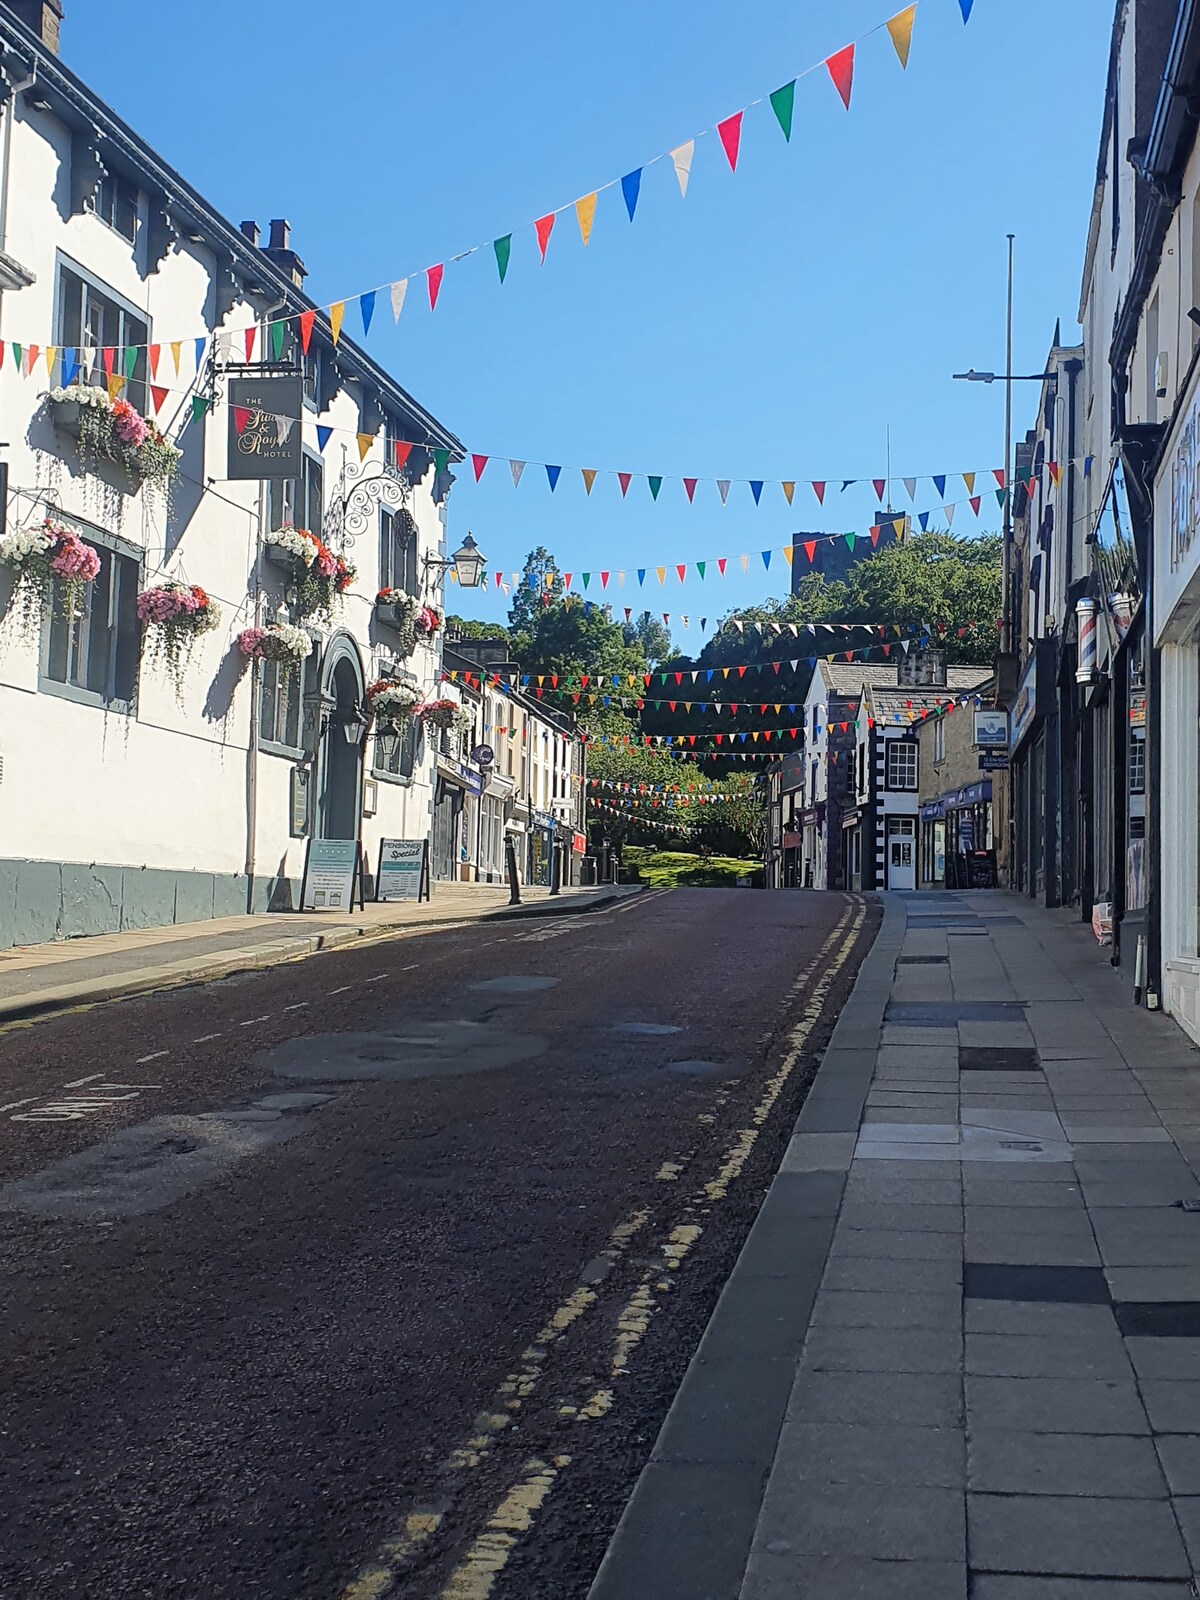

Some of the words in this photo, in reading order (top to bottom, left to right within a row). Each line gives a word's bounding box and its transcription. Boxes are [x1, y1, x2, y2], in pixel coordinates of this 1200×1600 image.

[244, 406, 277, 430] Swa
[258, 422, 271, 434] &
[237, 431, 292, 455] Roy
